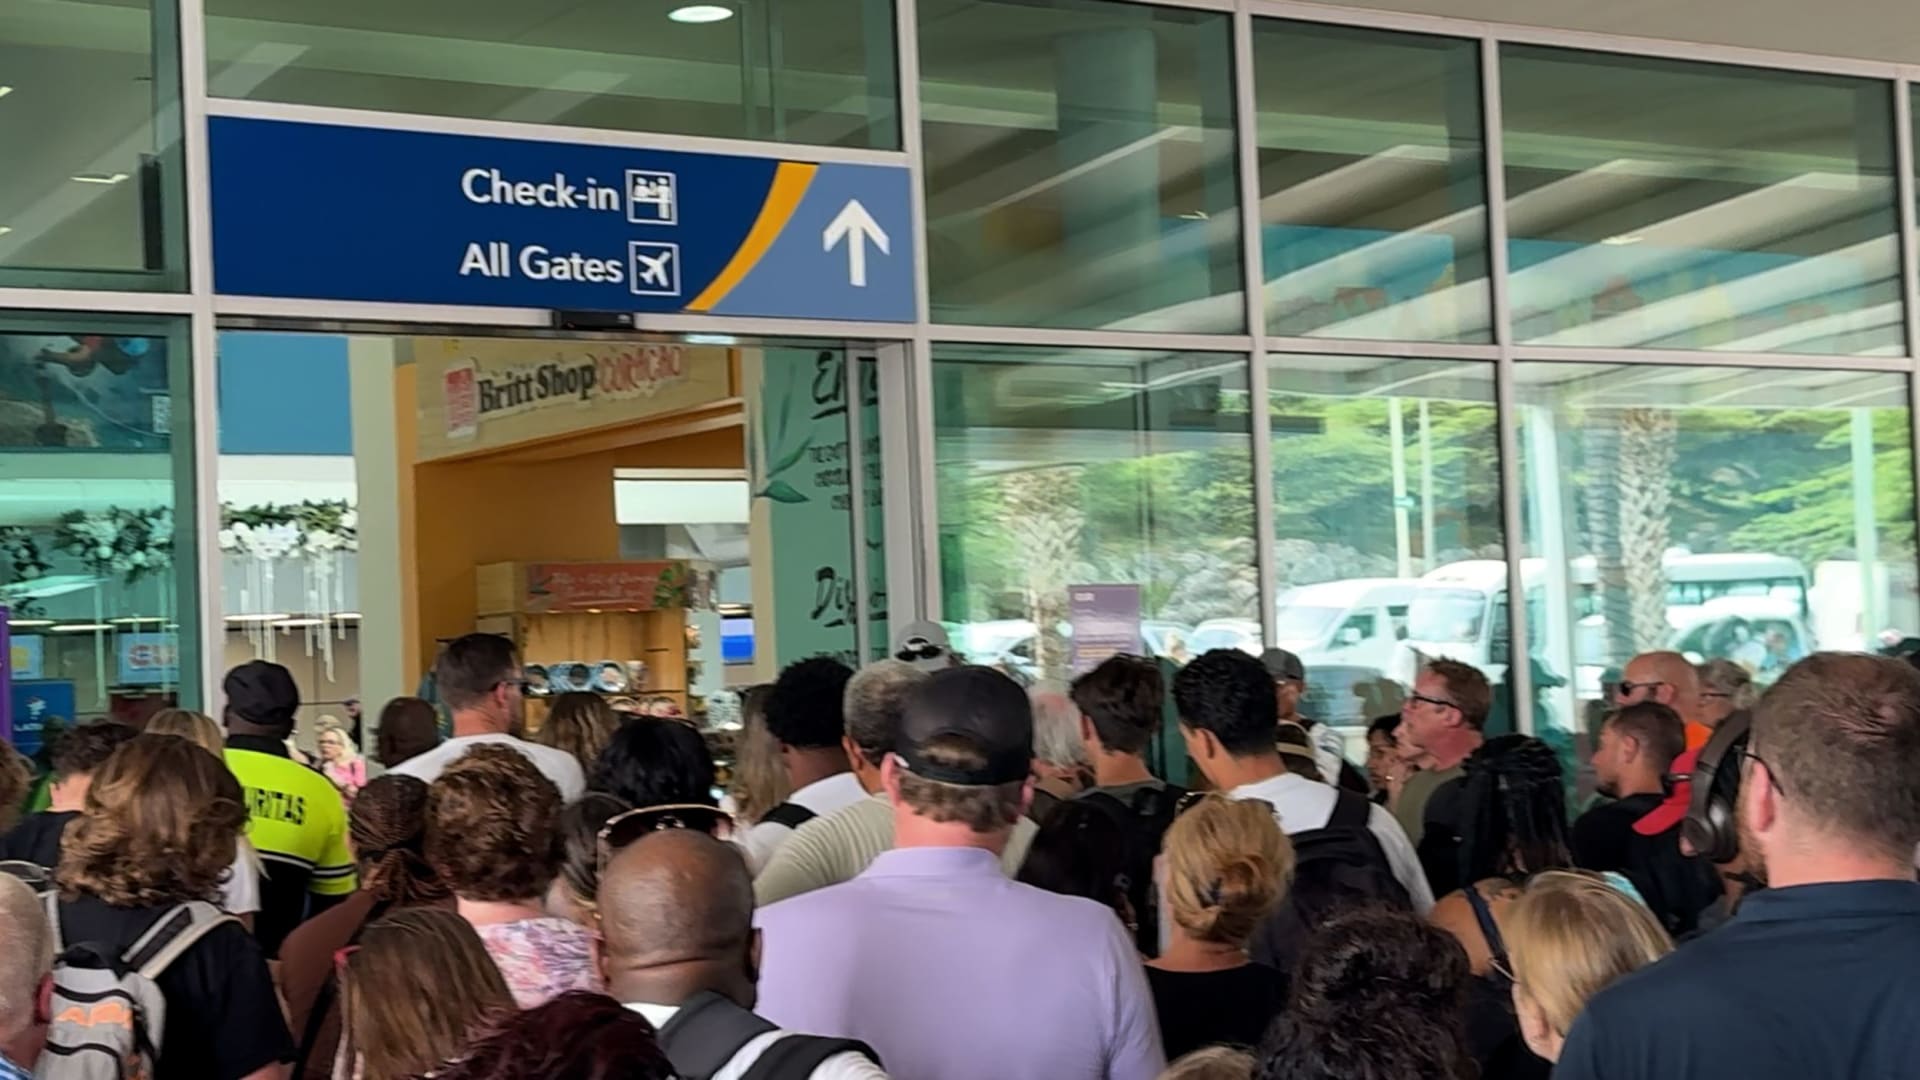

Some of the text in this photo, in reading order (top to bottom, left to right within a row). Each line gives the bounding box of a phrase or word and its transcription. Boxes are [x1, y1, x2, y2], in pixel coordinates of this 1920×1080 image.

[461, 168, 620, 212] Check-in
[459, 242, 624, 284] All Gates
[478, 371, 534, 414] Britt
[536, 364, 595, 401] Shop
